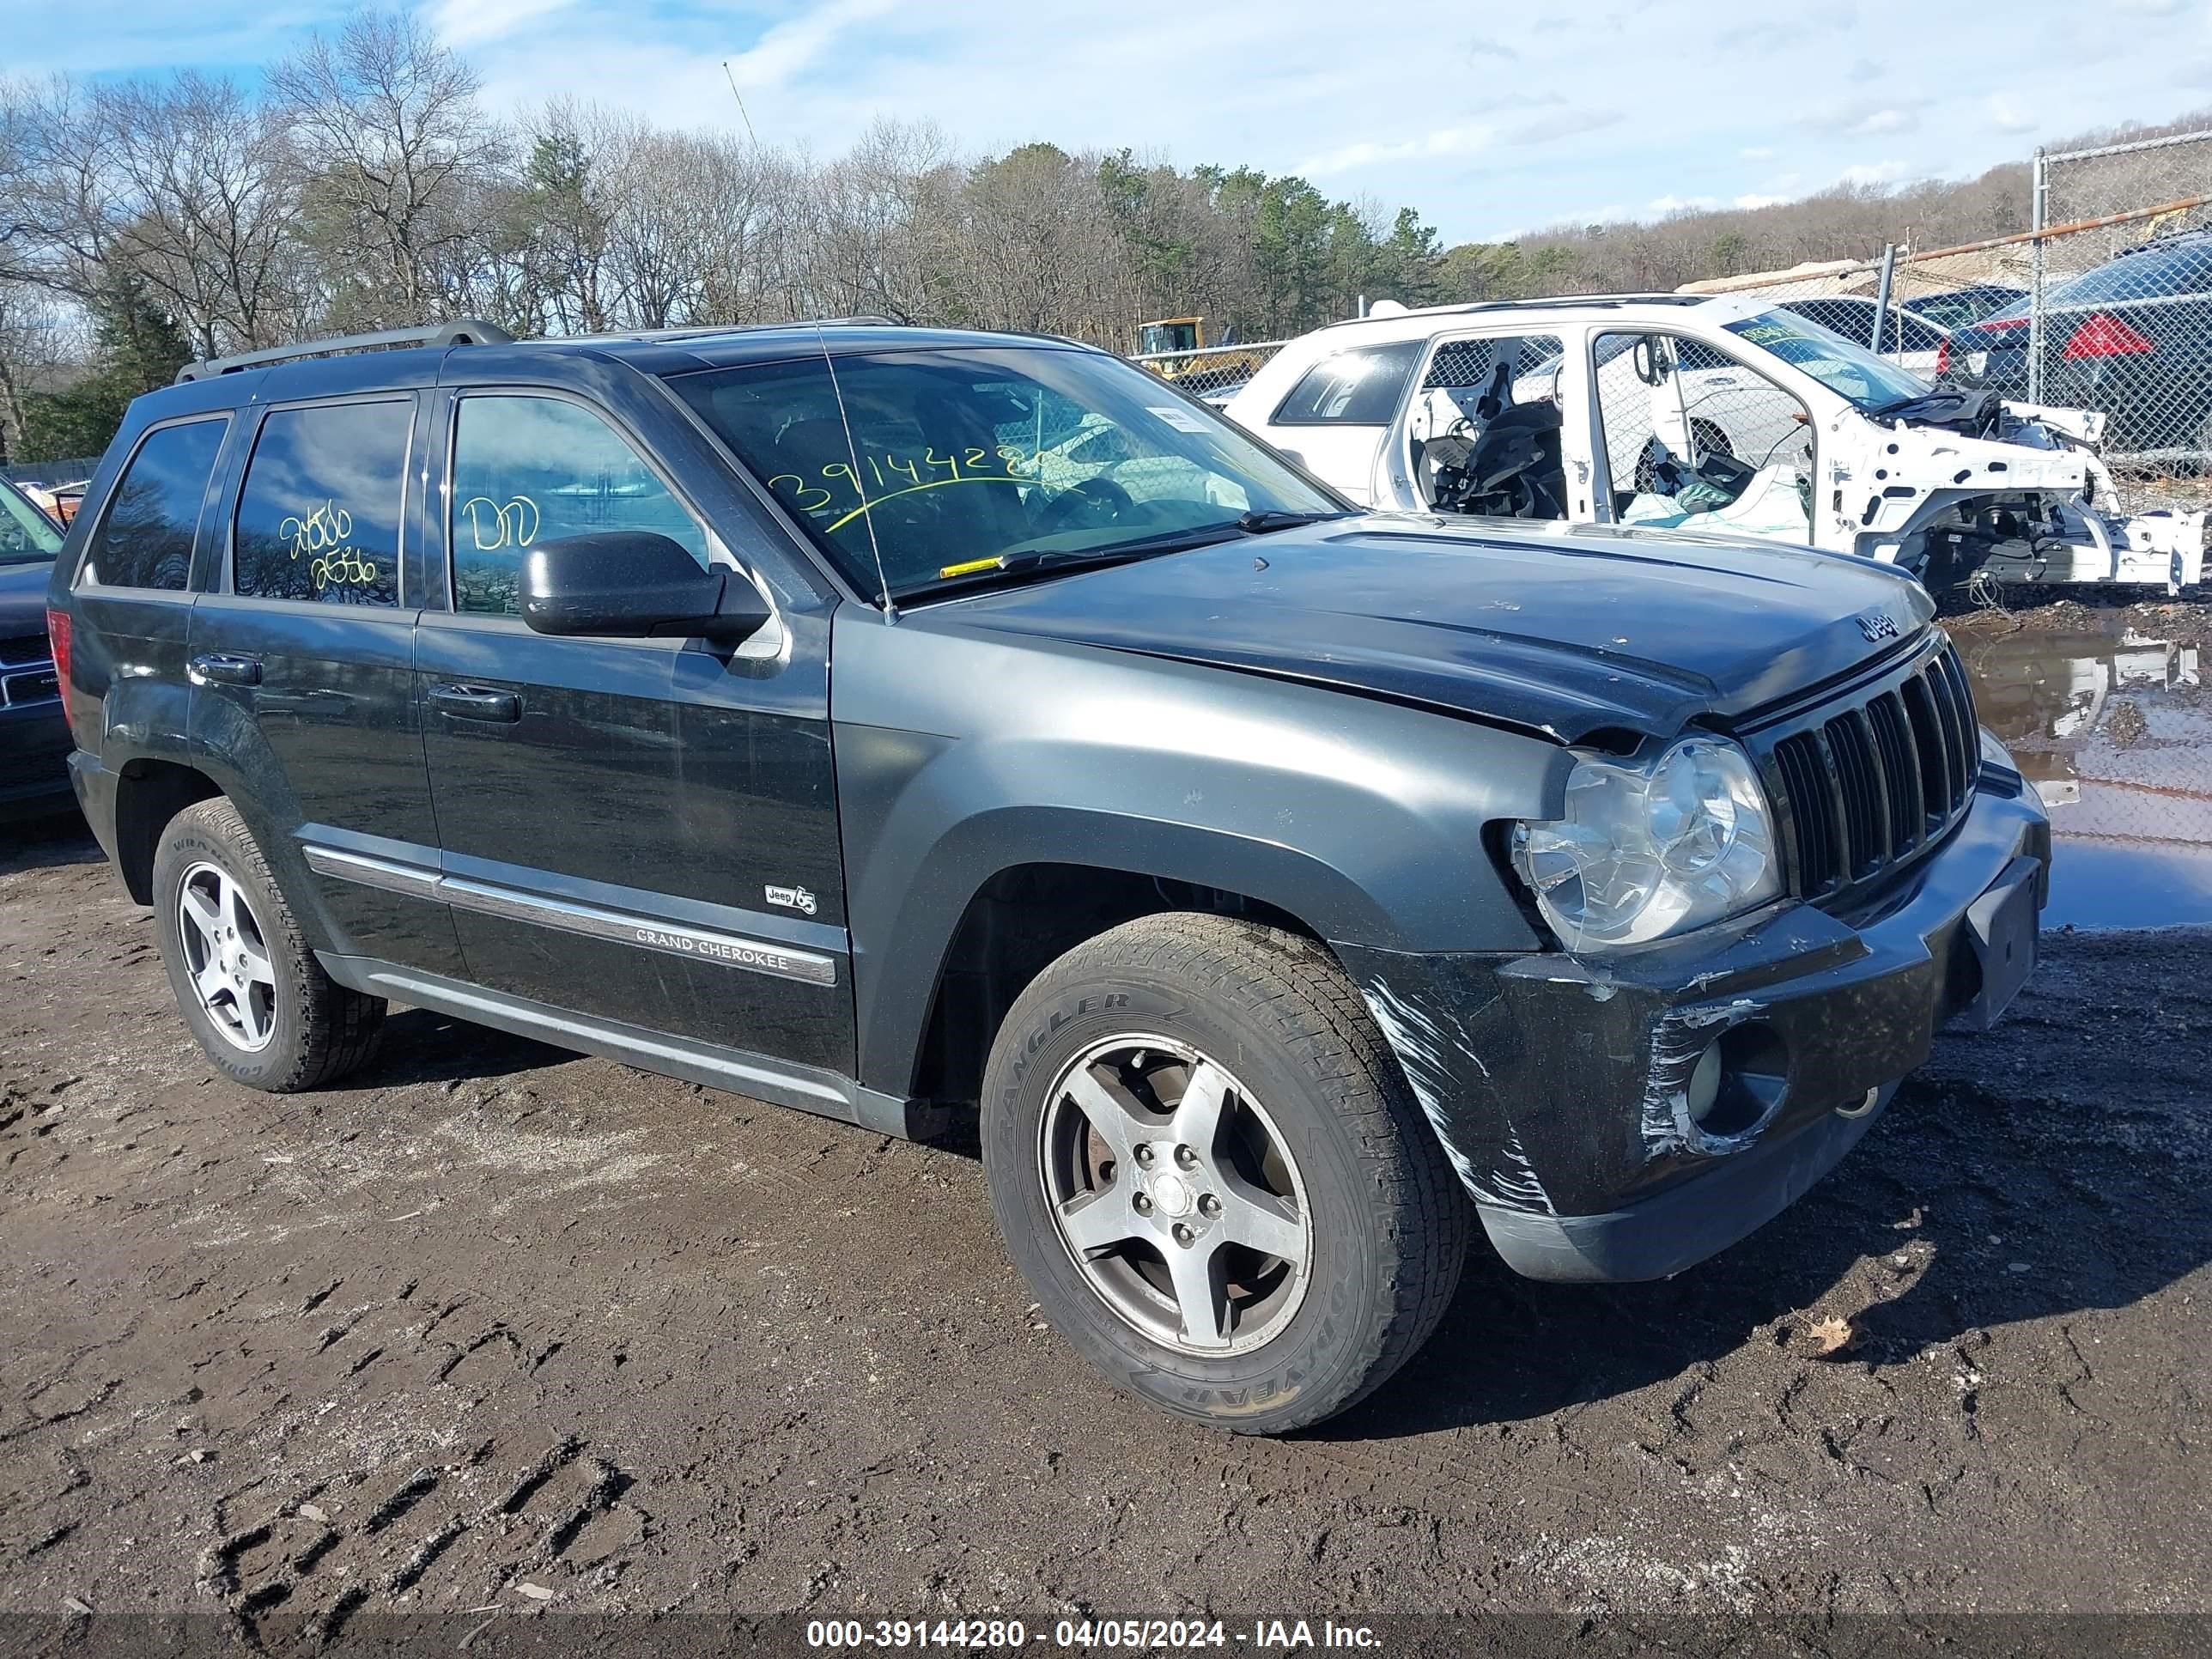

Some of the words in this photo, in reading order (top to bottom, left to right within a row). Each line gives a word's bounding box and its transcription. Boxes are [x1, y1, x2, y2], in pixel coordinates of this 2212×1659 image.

[1855, 613, 1900, 643] Jeep
[768, 888, 792, 904] Jeep
[796, 886, 817, 915] 65
[636, 929, 694, 951] GRAND
[698, 941, 790, 970] CHEROKEE
[1000, 993, 1132, 1195] WRANGLER
